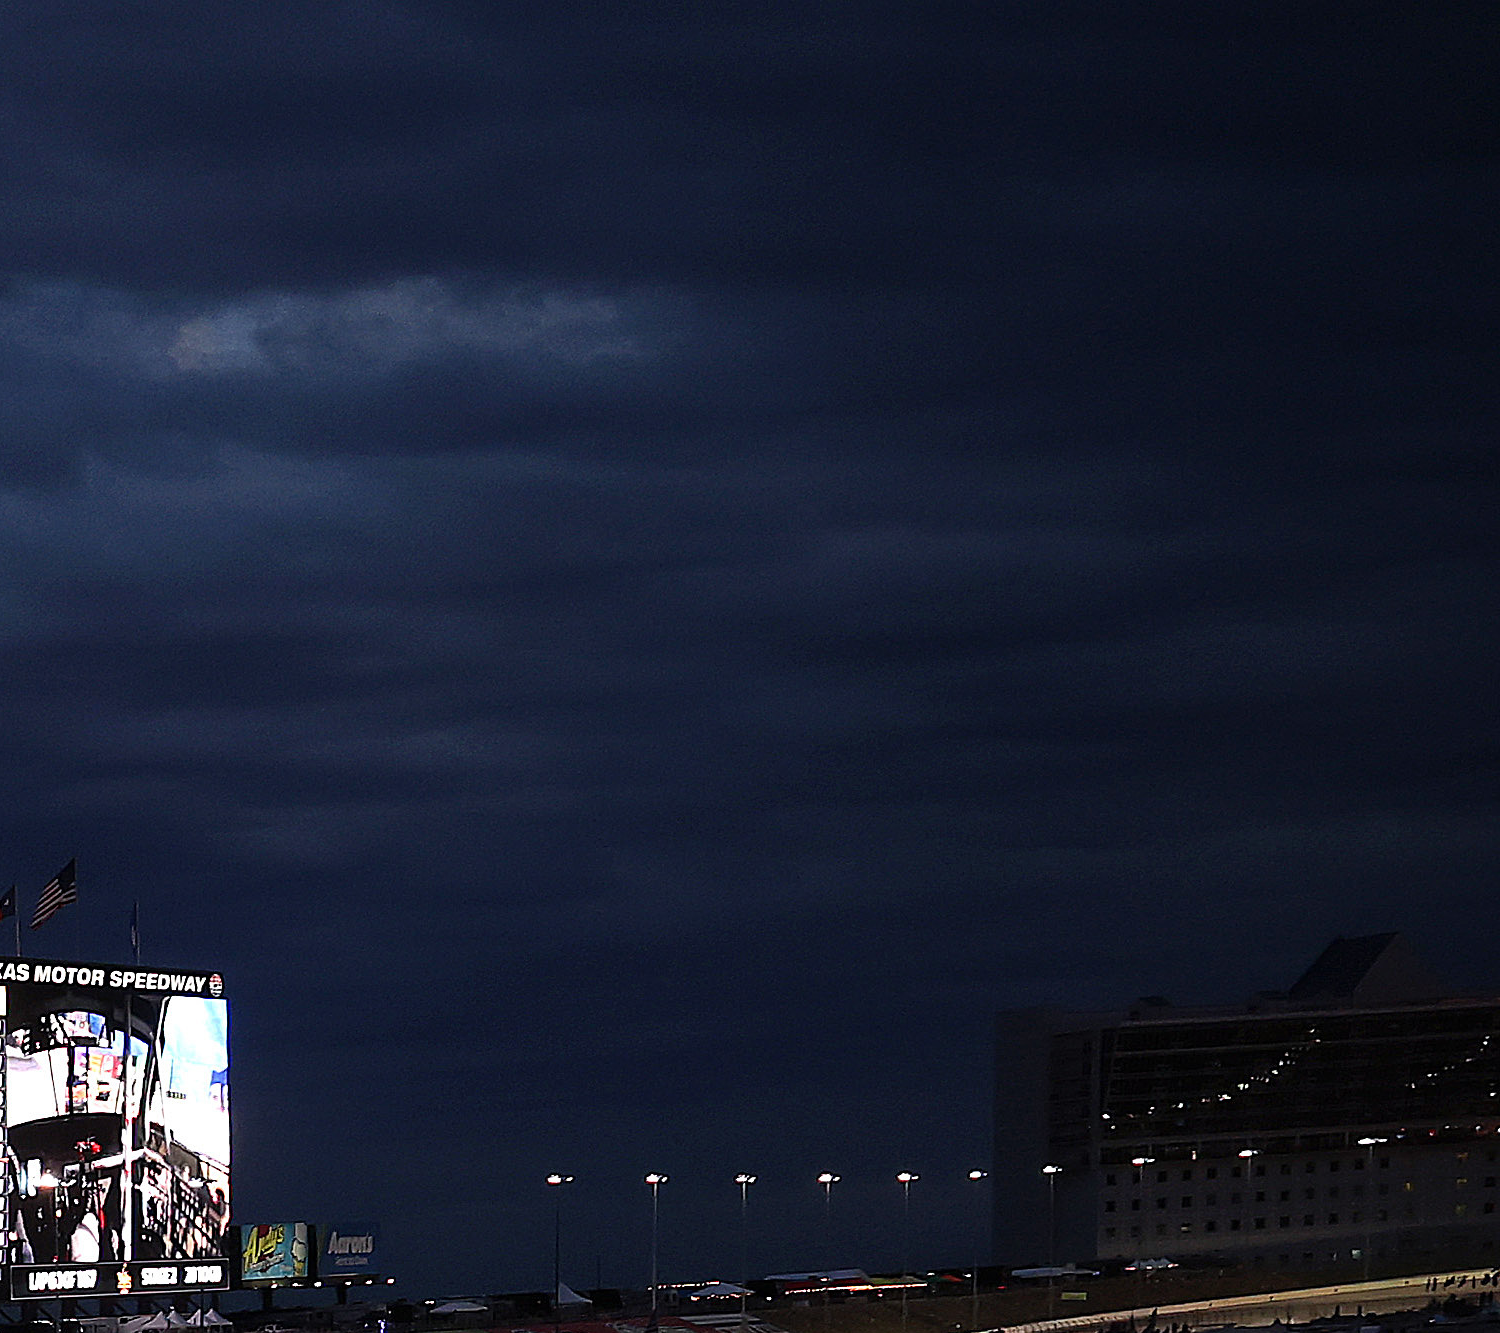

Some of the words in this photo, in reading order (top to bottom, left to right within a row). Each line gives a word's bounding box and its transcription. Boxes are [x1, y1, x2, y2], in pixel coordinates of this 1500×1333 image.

[34, 965, 105, 986] MOTOR
[109, 970, 207, 992] SPEEDWAY
[327, 1231, 374, 1254] Aaron's
